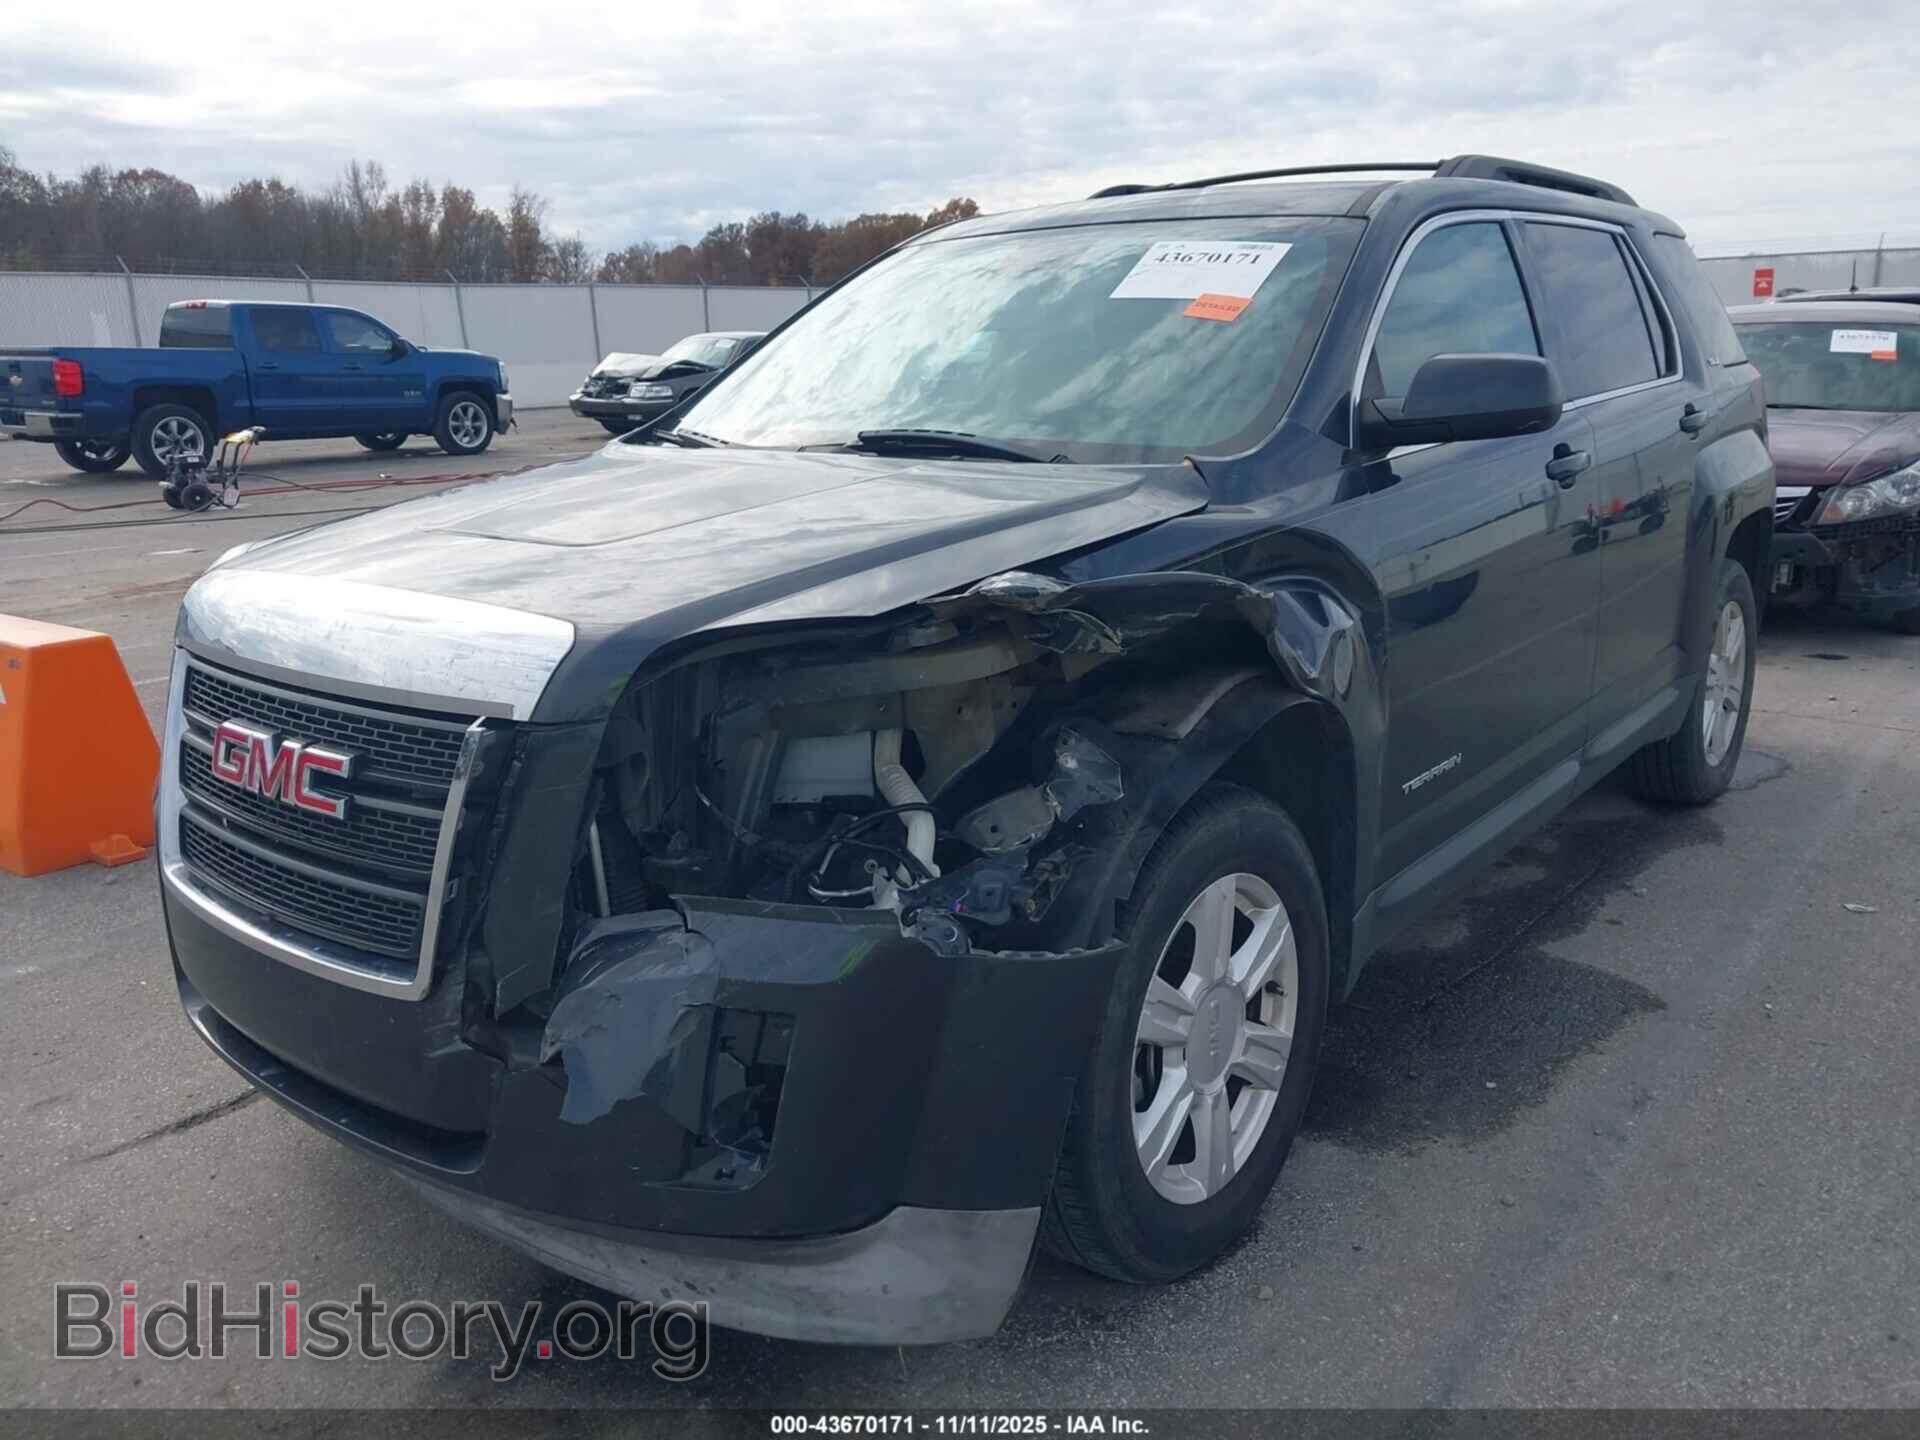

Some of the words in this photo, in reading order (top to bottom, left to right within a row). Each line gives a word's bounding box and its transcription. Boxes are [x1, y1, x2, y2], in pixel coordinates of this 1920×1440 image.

[1153, 251, 1262, 265] 43670171
[211, 720, 352, 820] GMC
[1401, 752, 1463, 795] TERRAIN
